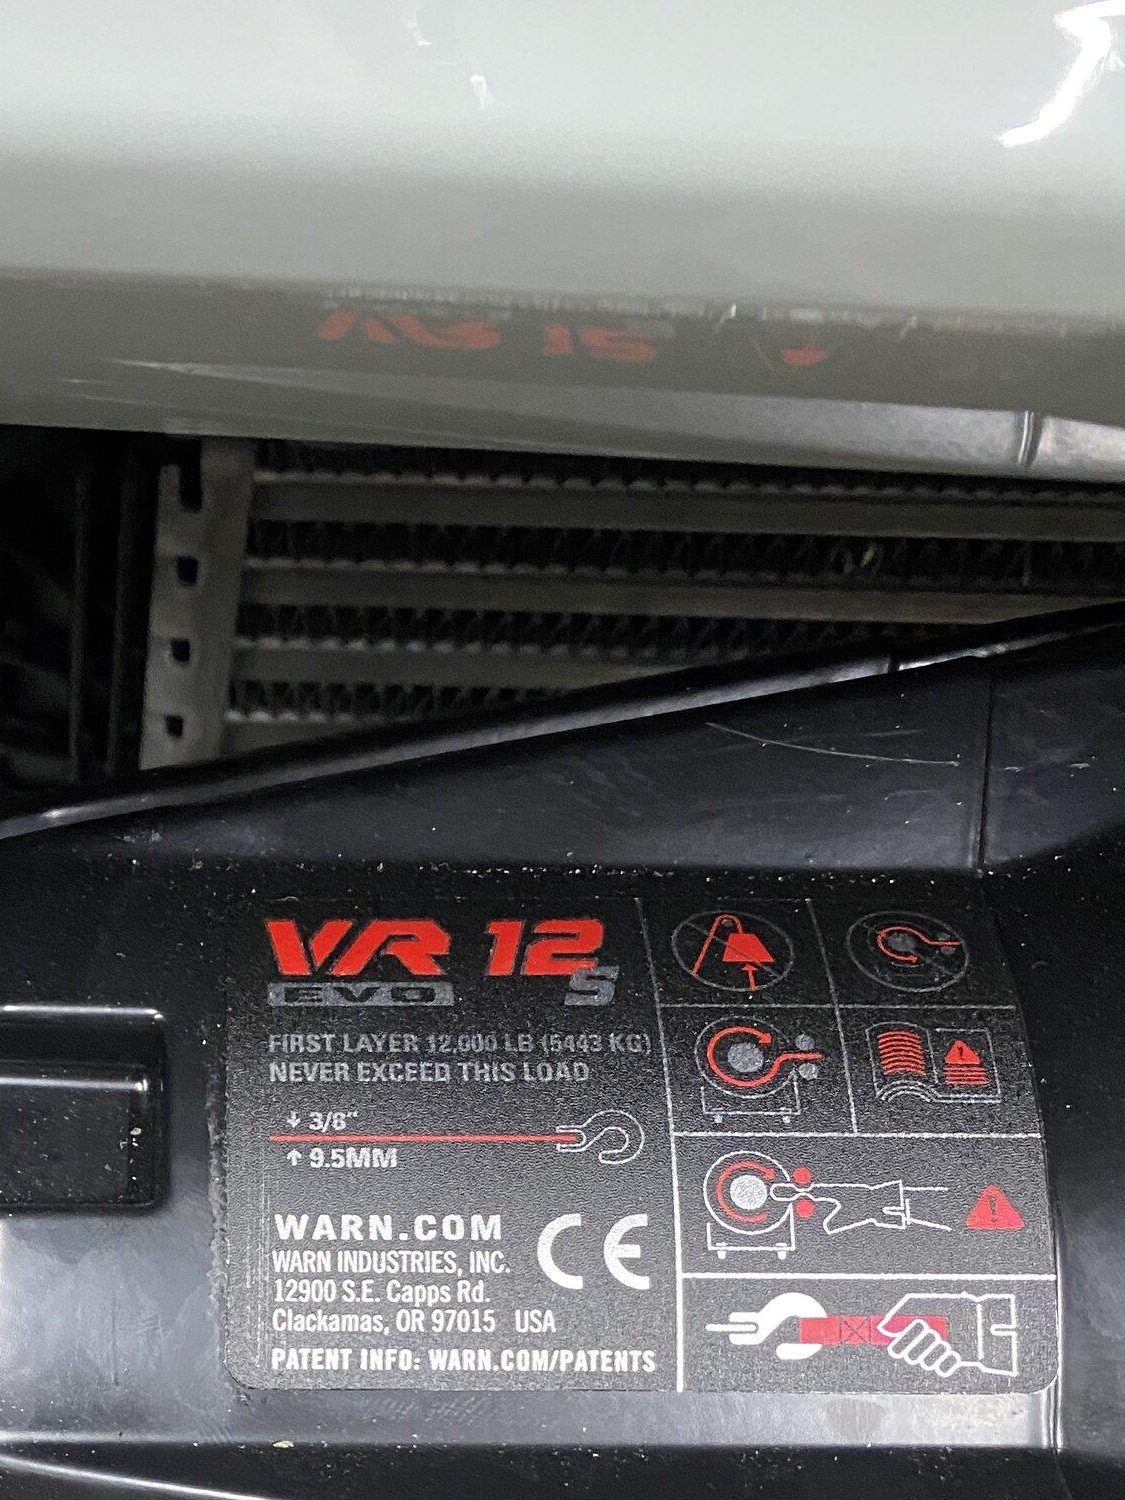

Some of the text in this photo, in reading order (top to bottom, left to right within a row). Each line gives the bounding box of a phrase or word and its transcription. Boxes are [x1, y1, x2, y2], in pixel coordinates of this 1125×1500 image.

[265, 918, 451, 976] VR
[282, 985, 439, 1005] EVO
[268, 1034, 335, 1053] FIRST
[343, 1034, 418, 1053] LAYER
[505, 1034, 533, 1053] LB
[541, 1033, 603, 1054] (5443
[609, 1033, 651, 1054] KG)
[269, 1061, 590, 1083] NEVER EXCEED THIS LOAD
[309, 1149, 398, 1168] 9.5MM
[274, 1213, 502, 1241] WARN.COM
[272, 1250, 510, 1277] WARN INDUSTRIES, INC.
[537, 1213, 651, 1290] CE
[273, 1279, 490, 1307] 12900 S.E. Capps Rd.
[273, 1308, 557, 1335] Clackamas, OR 97015 USA
[272, 1348, 656, 1373] PATENT INFO: WARN.COM/PATENTS
